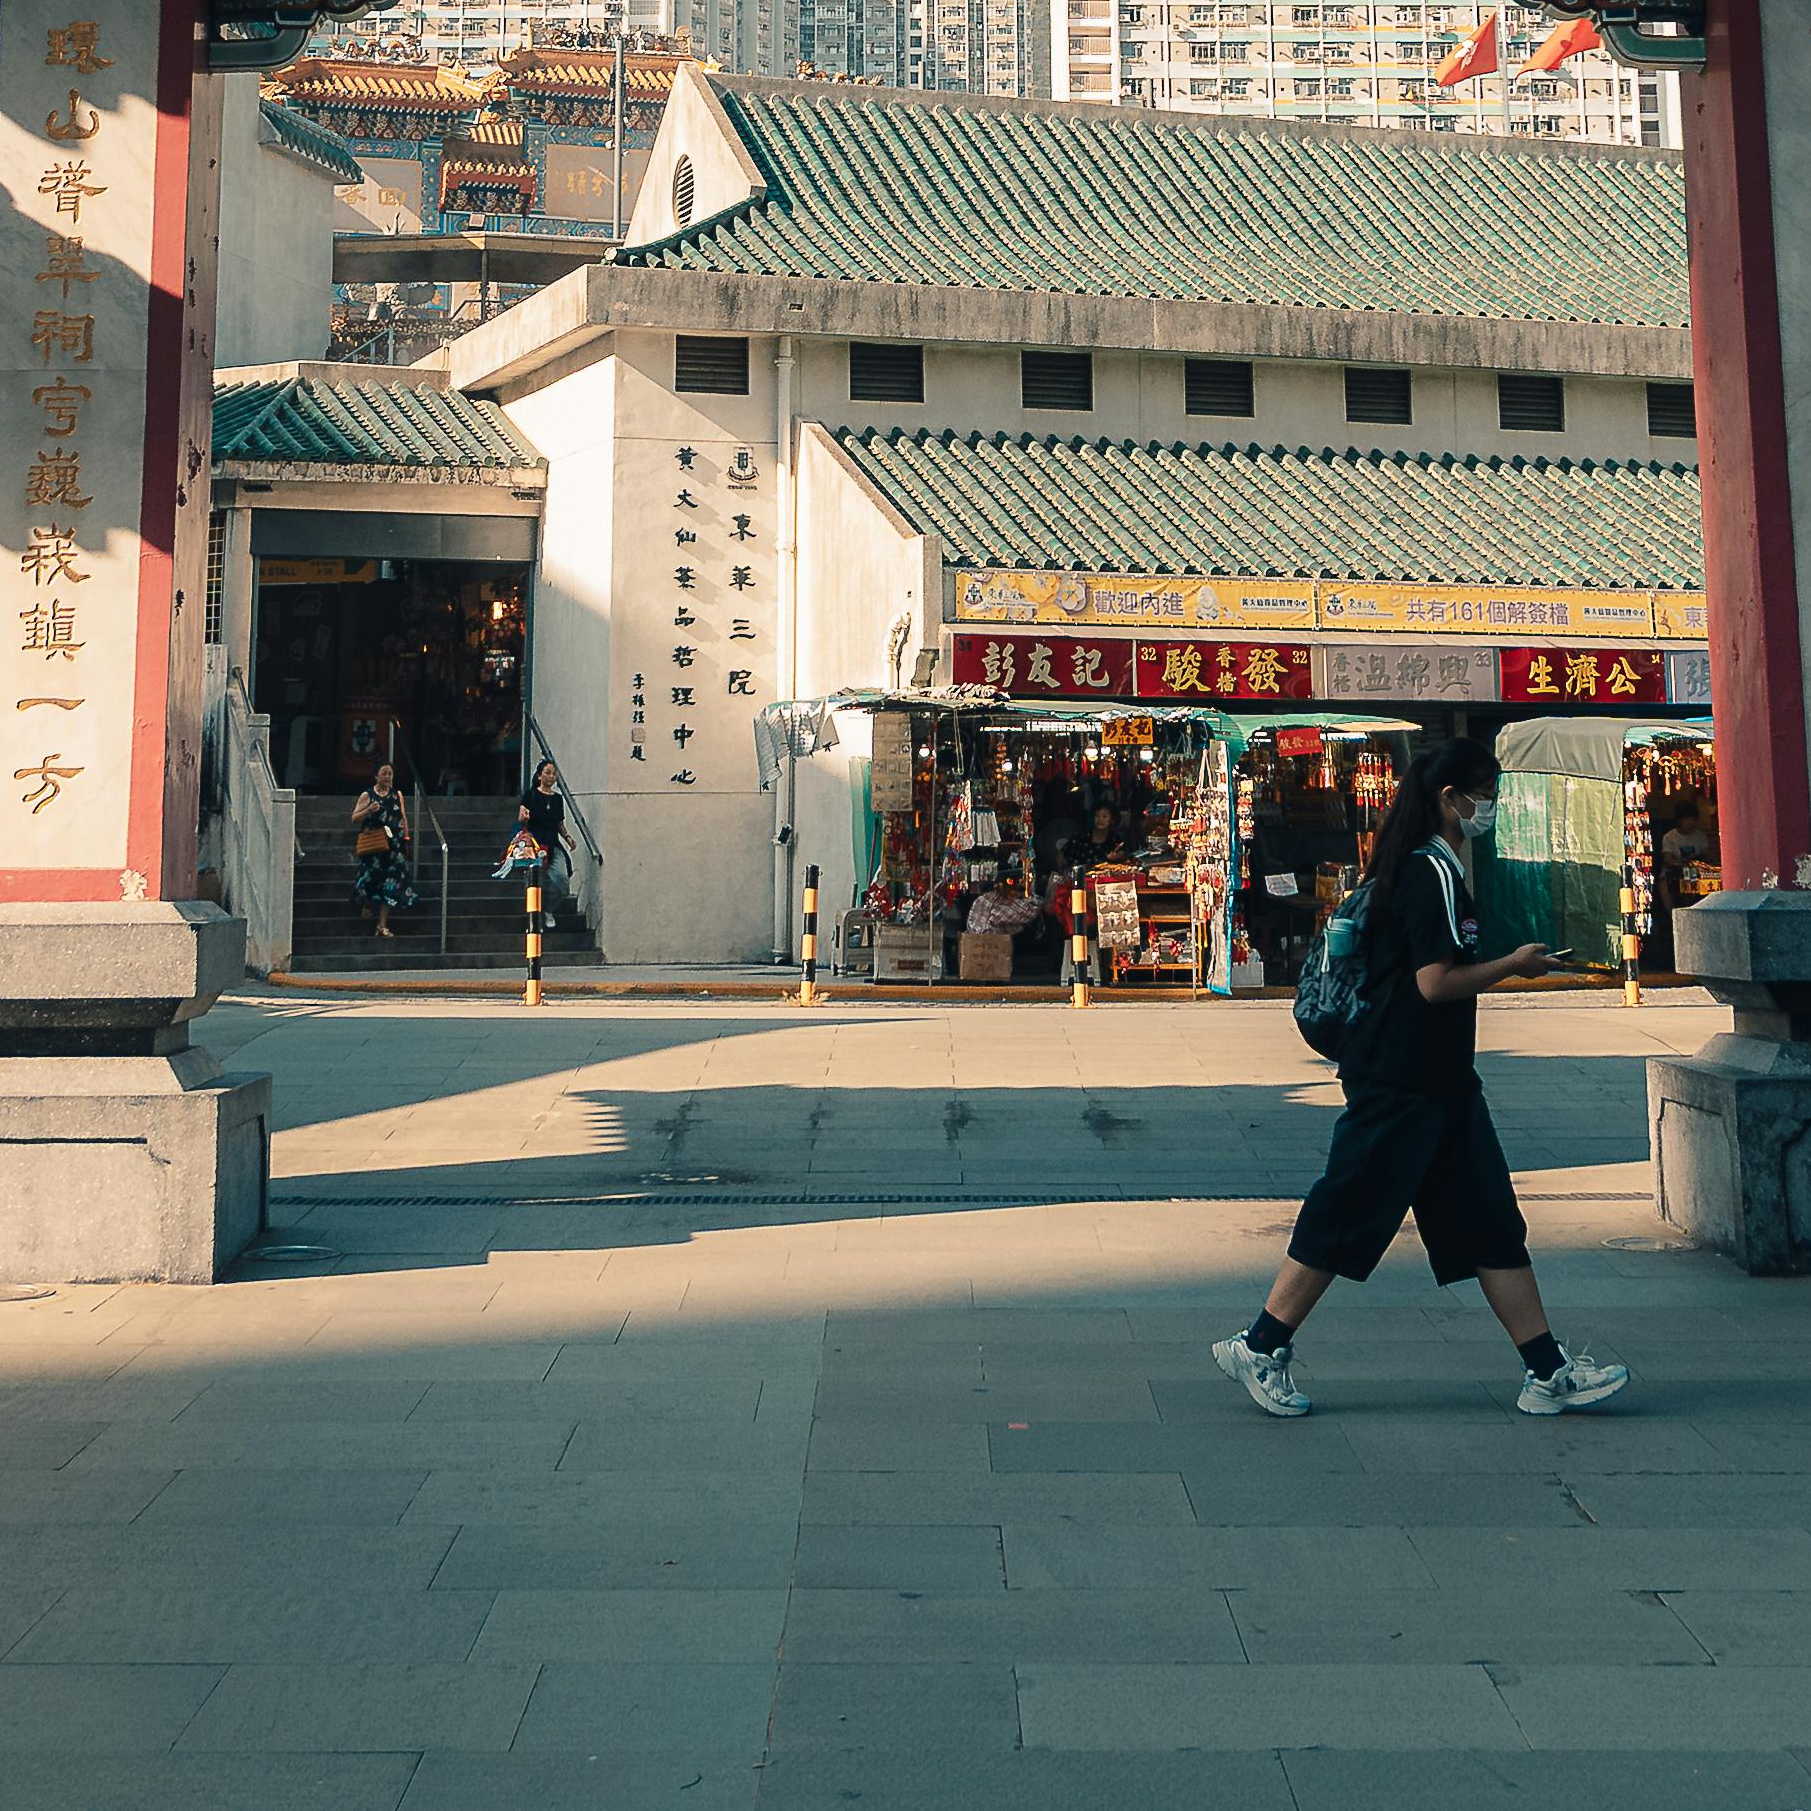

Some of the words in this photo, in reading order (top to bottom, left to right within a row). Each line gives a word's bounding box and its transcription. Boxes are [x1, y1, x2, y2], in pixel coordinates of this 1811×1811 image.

[728, 513, 757, 695] 東華三院
[1094, 590, 1185, 617] 歡迎內進
[1683, 606, 1708, 629] 東
[981, 641, 1111, 689] 彭友記
[1140, 646, 1157, 661] 32
[1291, 649, 1308, 664] 32
